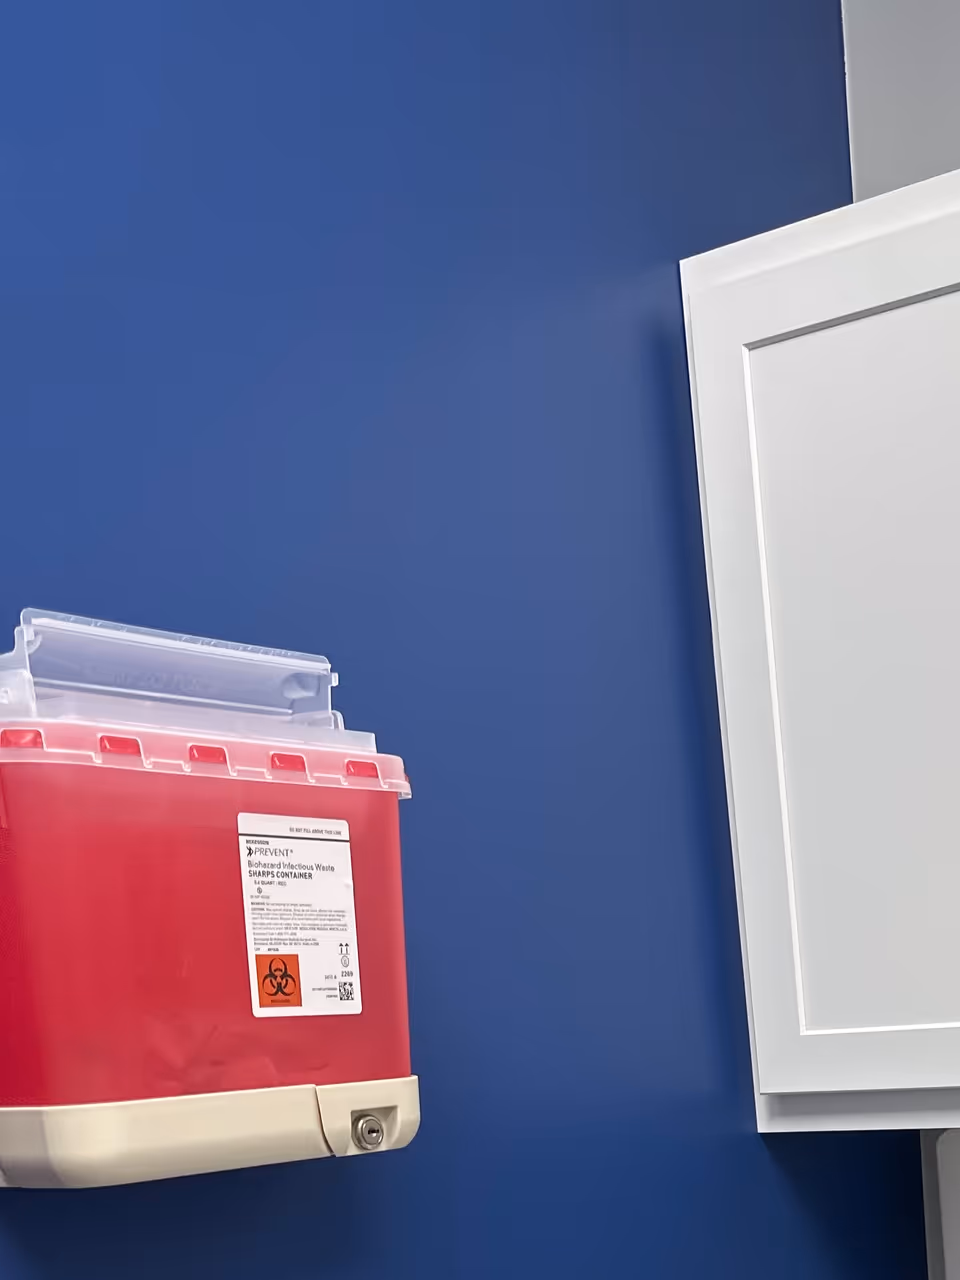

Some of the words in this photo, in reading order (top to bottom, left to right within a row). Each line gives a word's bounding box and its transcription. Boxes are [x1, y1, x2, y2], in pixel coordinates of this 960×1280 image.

[247, 860, 282, 870] Biohazard
[282, 862, 314, 871] Infectious
[314, 863, 335, 872] Waste
[248, 870, 275, 878] SHARPS
[276, 871, 313, 880] CONTAINER
